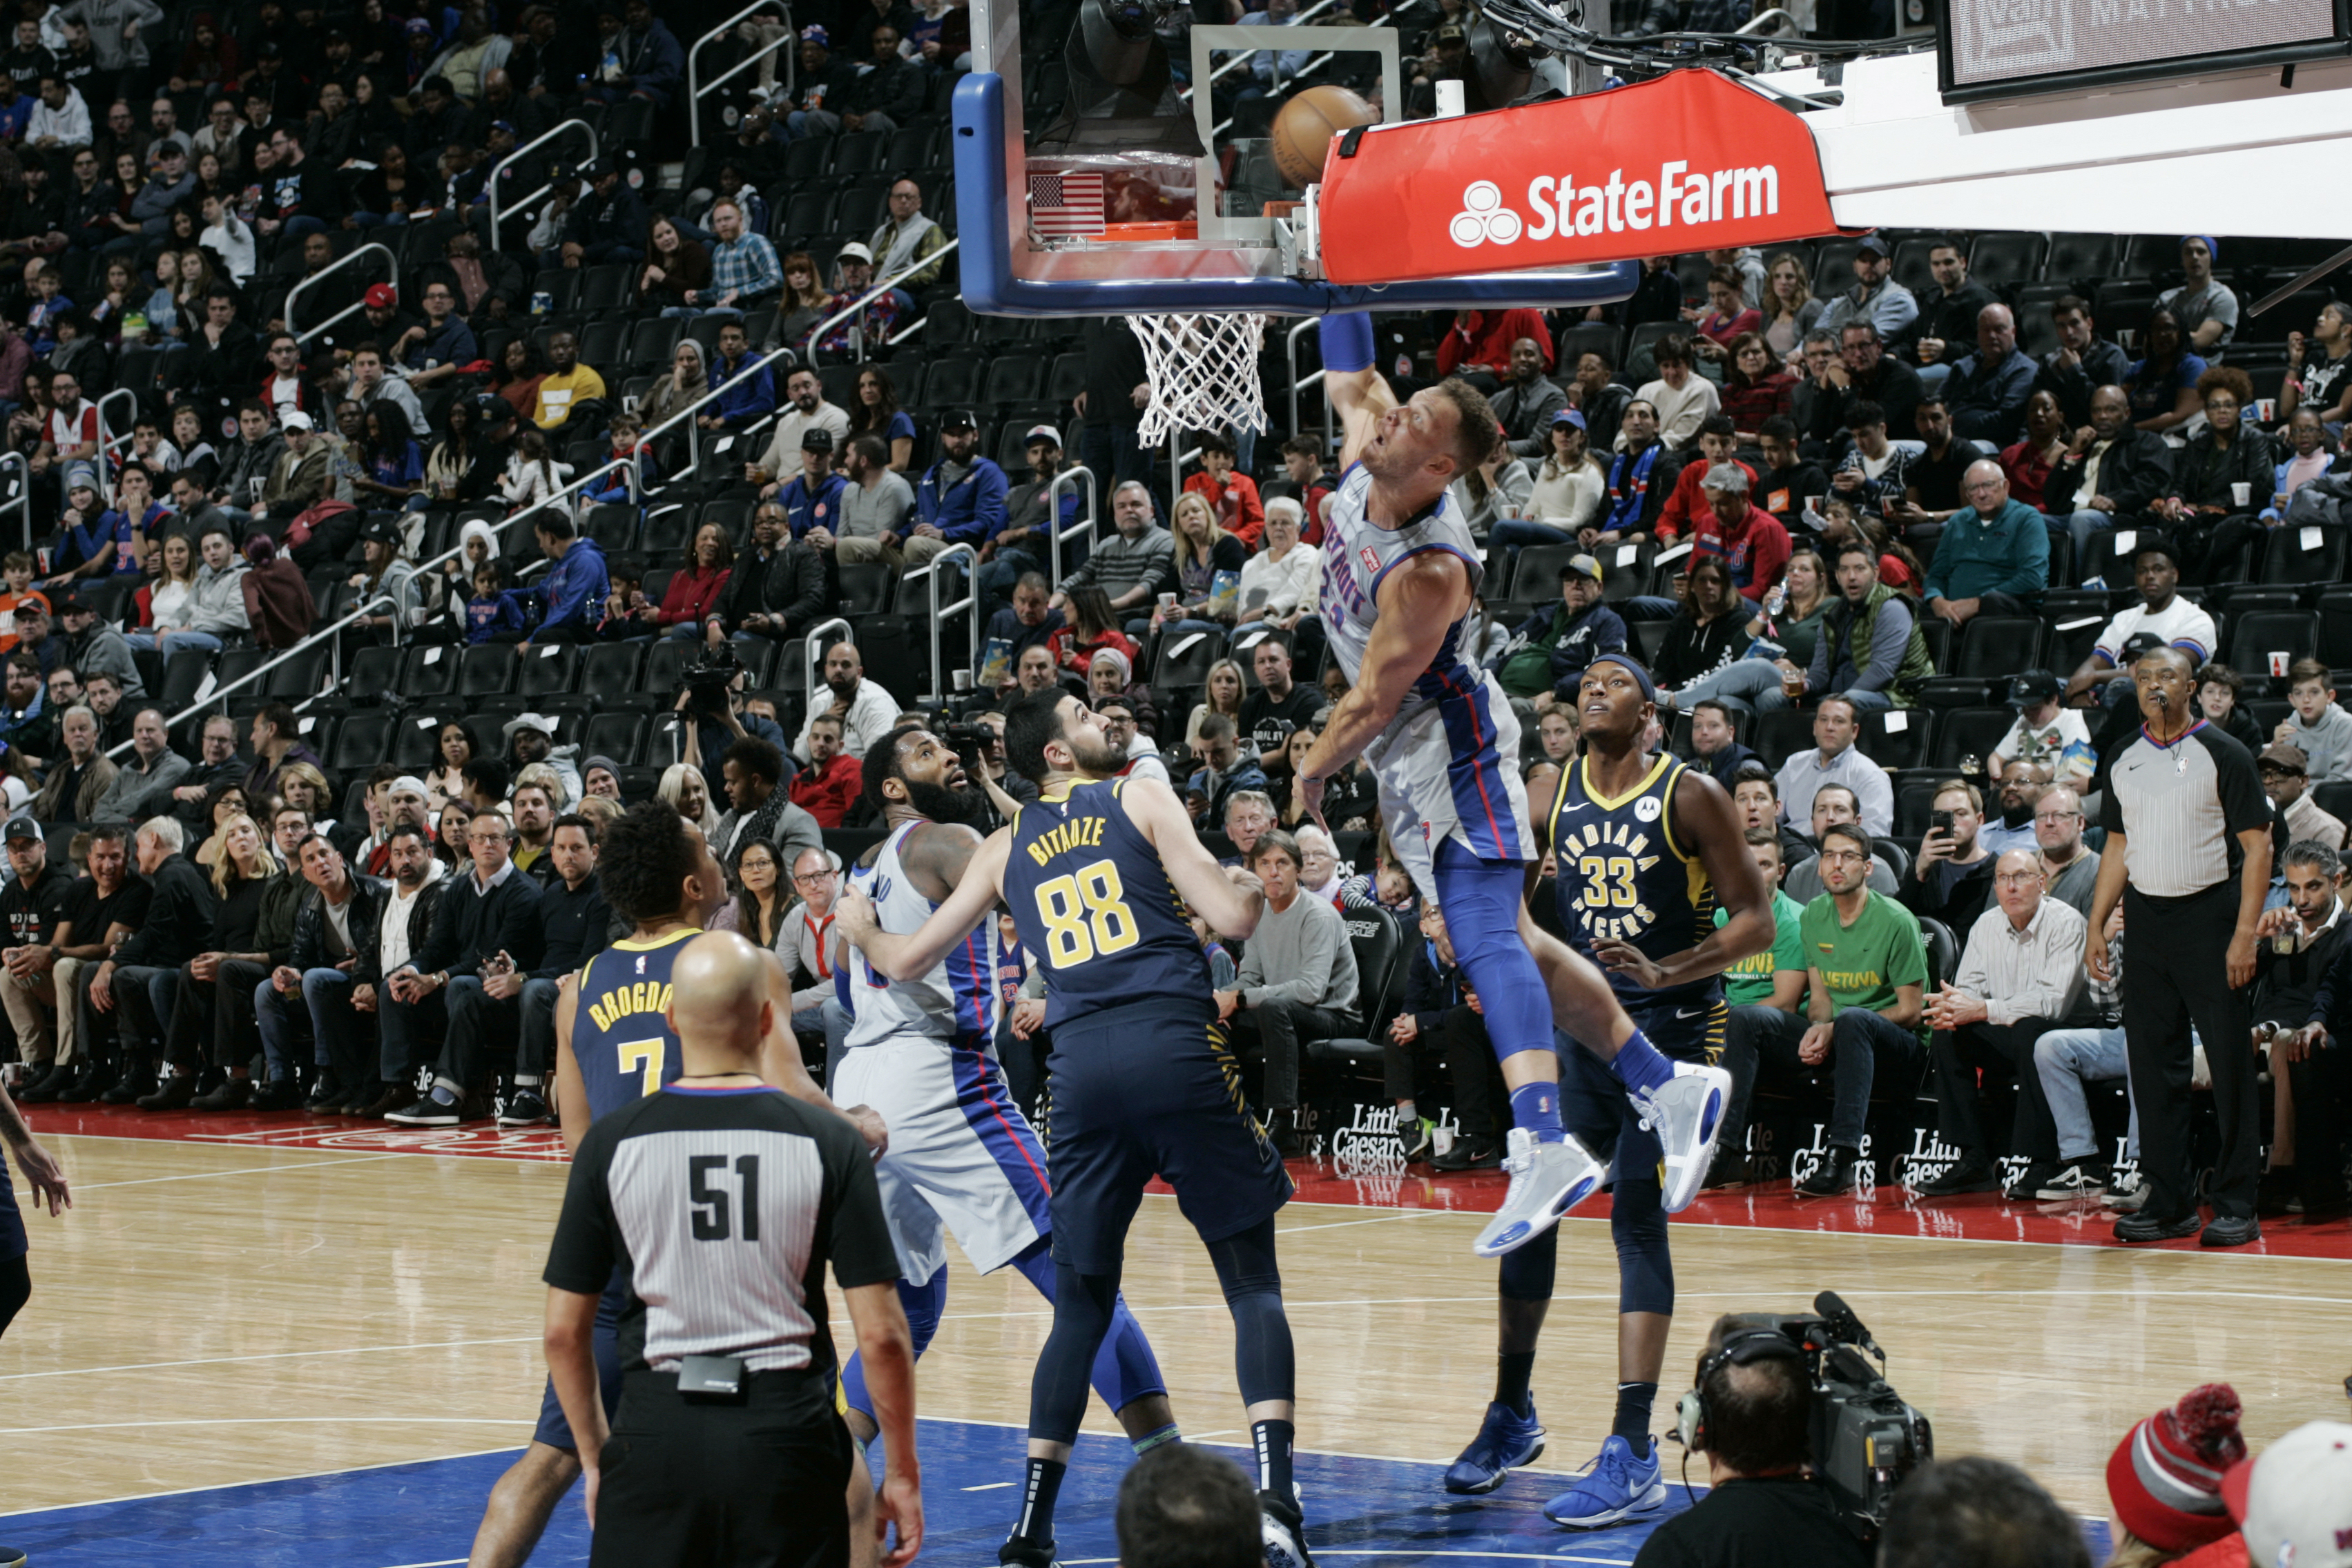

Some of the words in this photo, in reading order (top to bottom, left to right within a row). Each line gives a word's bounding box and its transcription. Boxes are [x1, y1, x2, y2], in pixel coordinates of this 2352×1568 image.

[1027, 816, 1107, 867] BITADZE
[1561, 821, 1661, 873] INDIANA
[1579, 855, 1637, 908] 33
[1034, 858, 1140, 969] 88
[1571, 897, 1656, 940] PACERS
[1820, 969, 1882, 989] LIETUVA
[588, 980, 674, 1033] BROGDO
[617, 1036, 664, 1098] 7
[689, 1154, 760, 1241] 51
